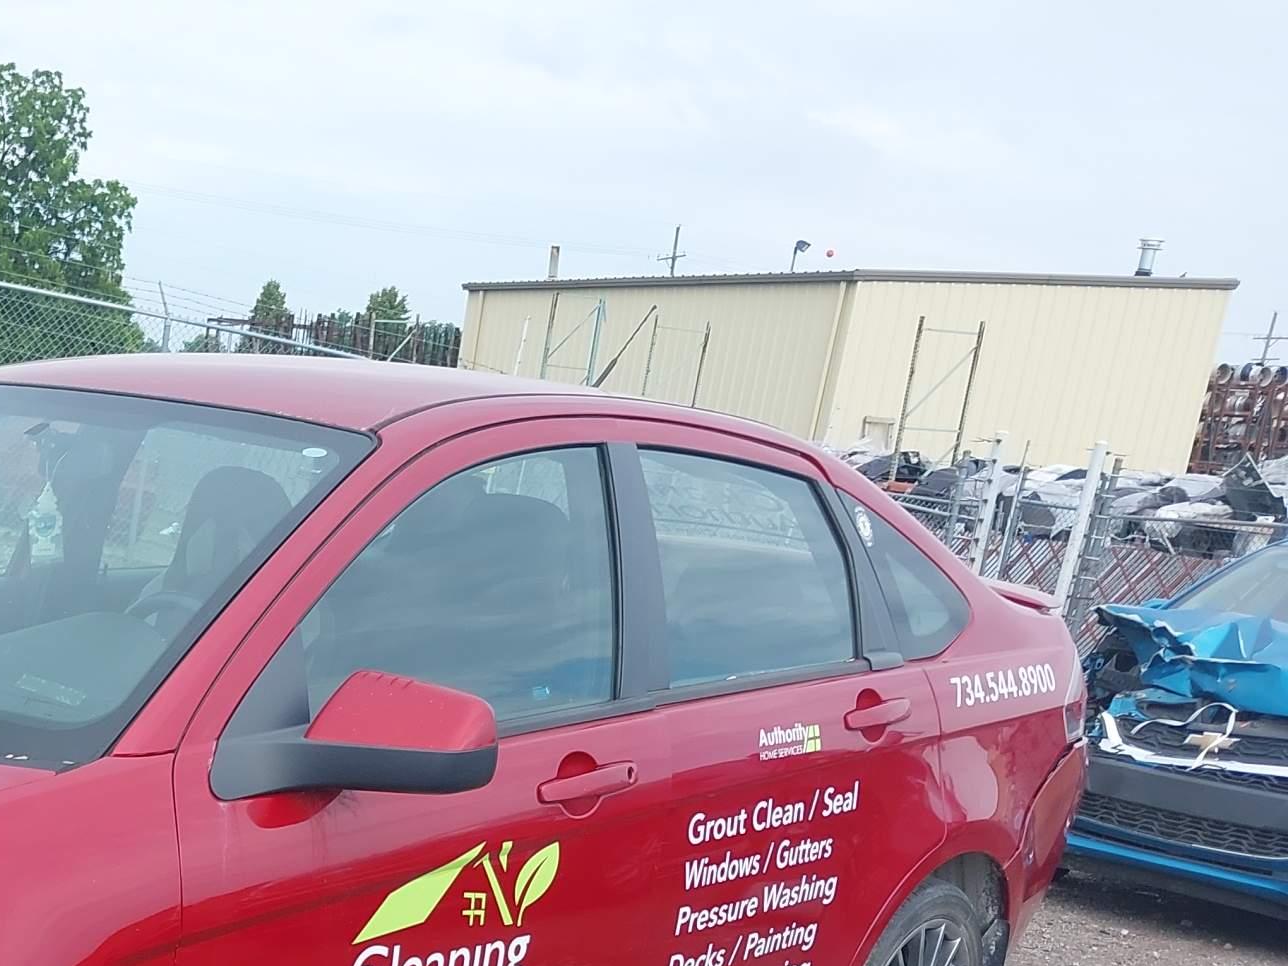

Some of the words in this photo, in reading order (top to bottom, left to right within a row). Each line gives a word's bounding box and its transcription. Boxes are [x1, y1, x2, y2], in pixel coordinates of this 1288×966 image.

[949, 663, 1056, 708] 734.544.8900
[759, 722, 809, 754] Authority
[759, 749, 778, 761] HOME
[688, 807, 747, 845] Grout
[752, 798, 805, 831] Clean
[808, 789, 820, 821] /
[822, 780, 860, 817] Seal
[684, 850, 761, 890] Windows
[763, 841, 775, 874] /
[776, 837, 833, 869] Gutters
[675, 896, 759, 936] Pressure
[763, 874, 838, 912] Washing
[728, 935, 742, 966] /
[743, 922, 818, 960] Painting
